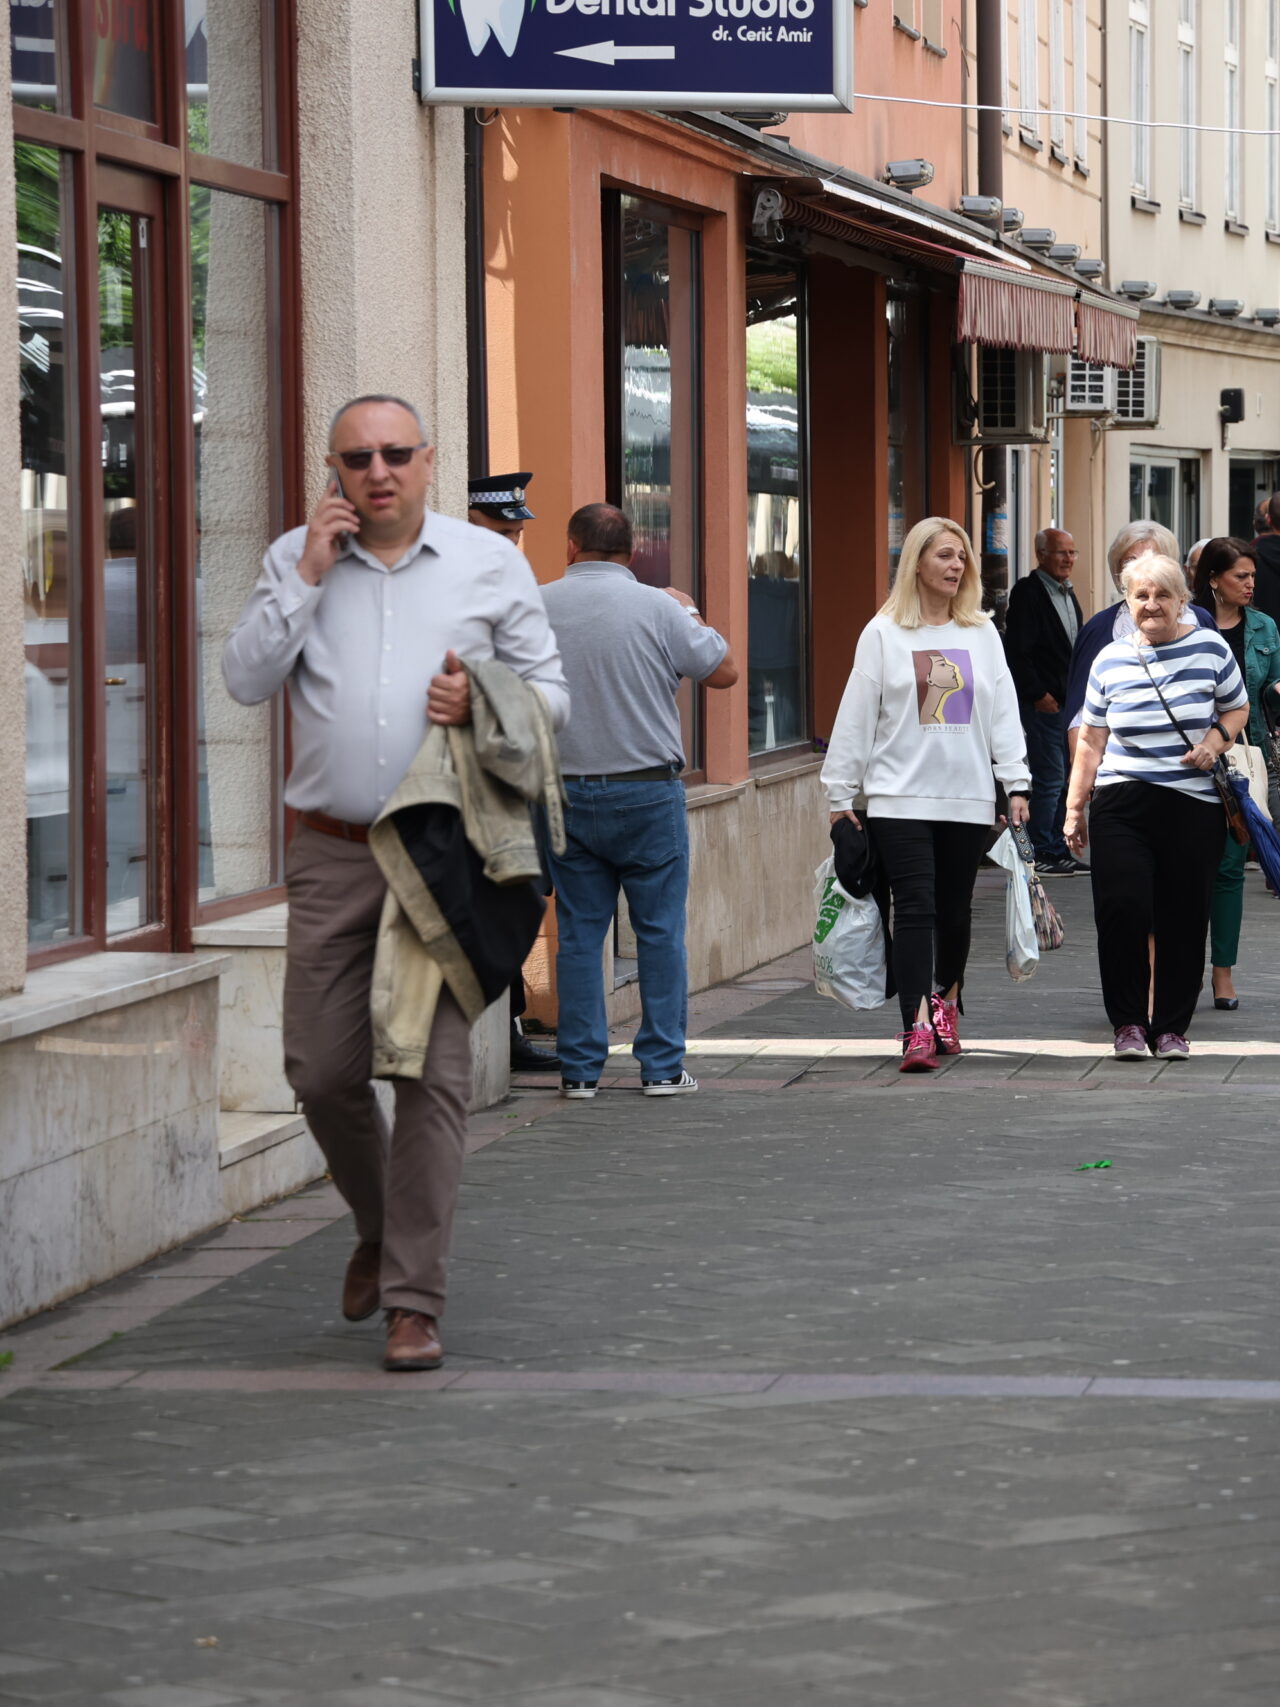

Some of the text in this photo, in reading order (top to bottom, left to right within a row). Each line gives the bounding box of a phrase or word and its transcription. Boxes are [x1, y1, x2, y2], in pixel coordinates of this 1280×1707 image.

[712, 25, 813, 42] dr. Cerić Amir
